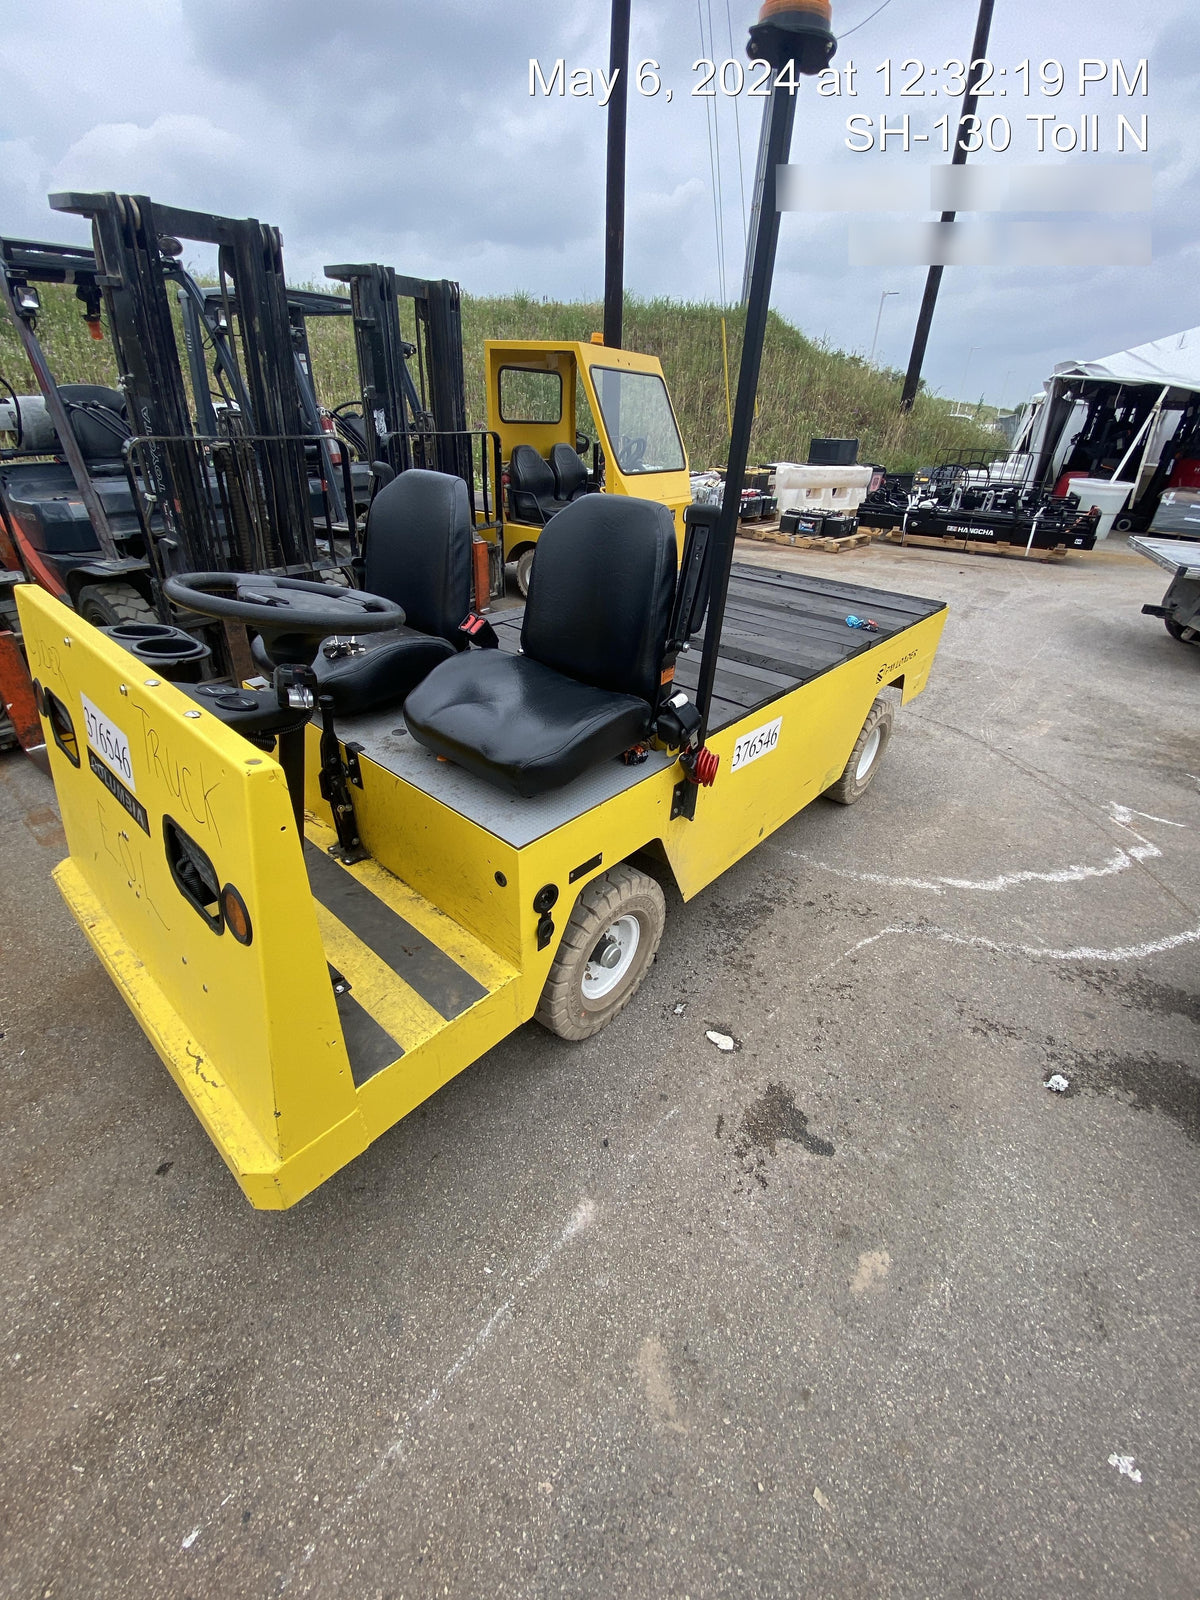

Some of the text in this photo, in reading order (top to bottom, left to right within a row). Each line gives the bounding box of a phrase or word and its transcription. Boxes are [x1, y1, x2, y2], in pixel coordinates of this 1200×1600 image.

[957, 526, 994, 536] HANGCHA
[83, 706, 131, 779] 376546
[131, 702, 222, 848] TRUCK
[732, 724, 779, 767] 376546
[90, 756, 148, 830] COLUMBIA
